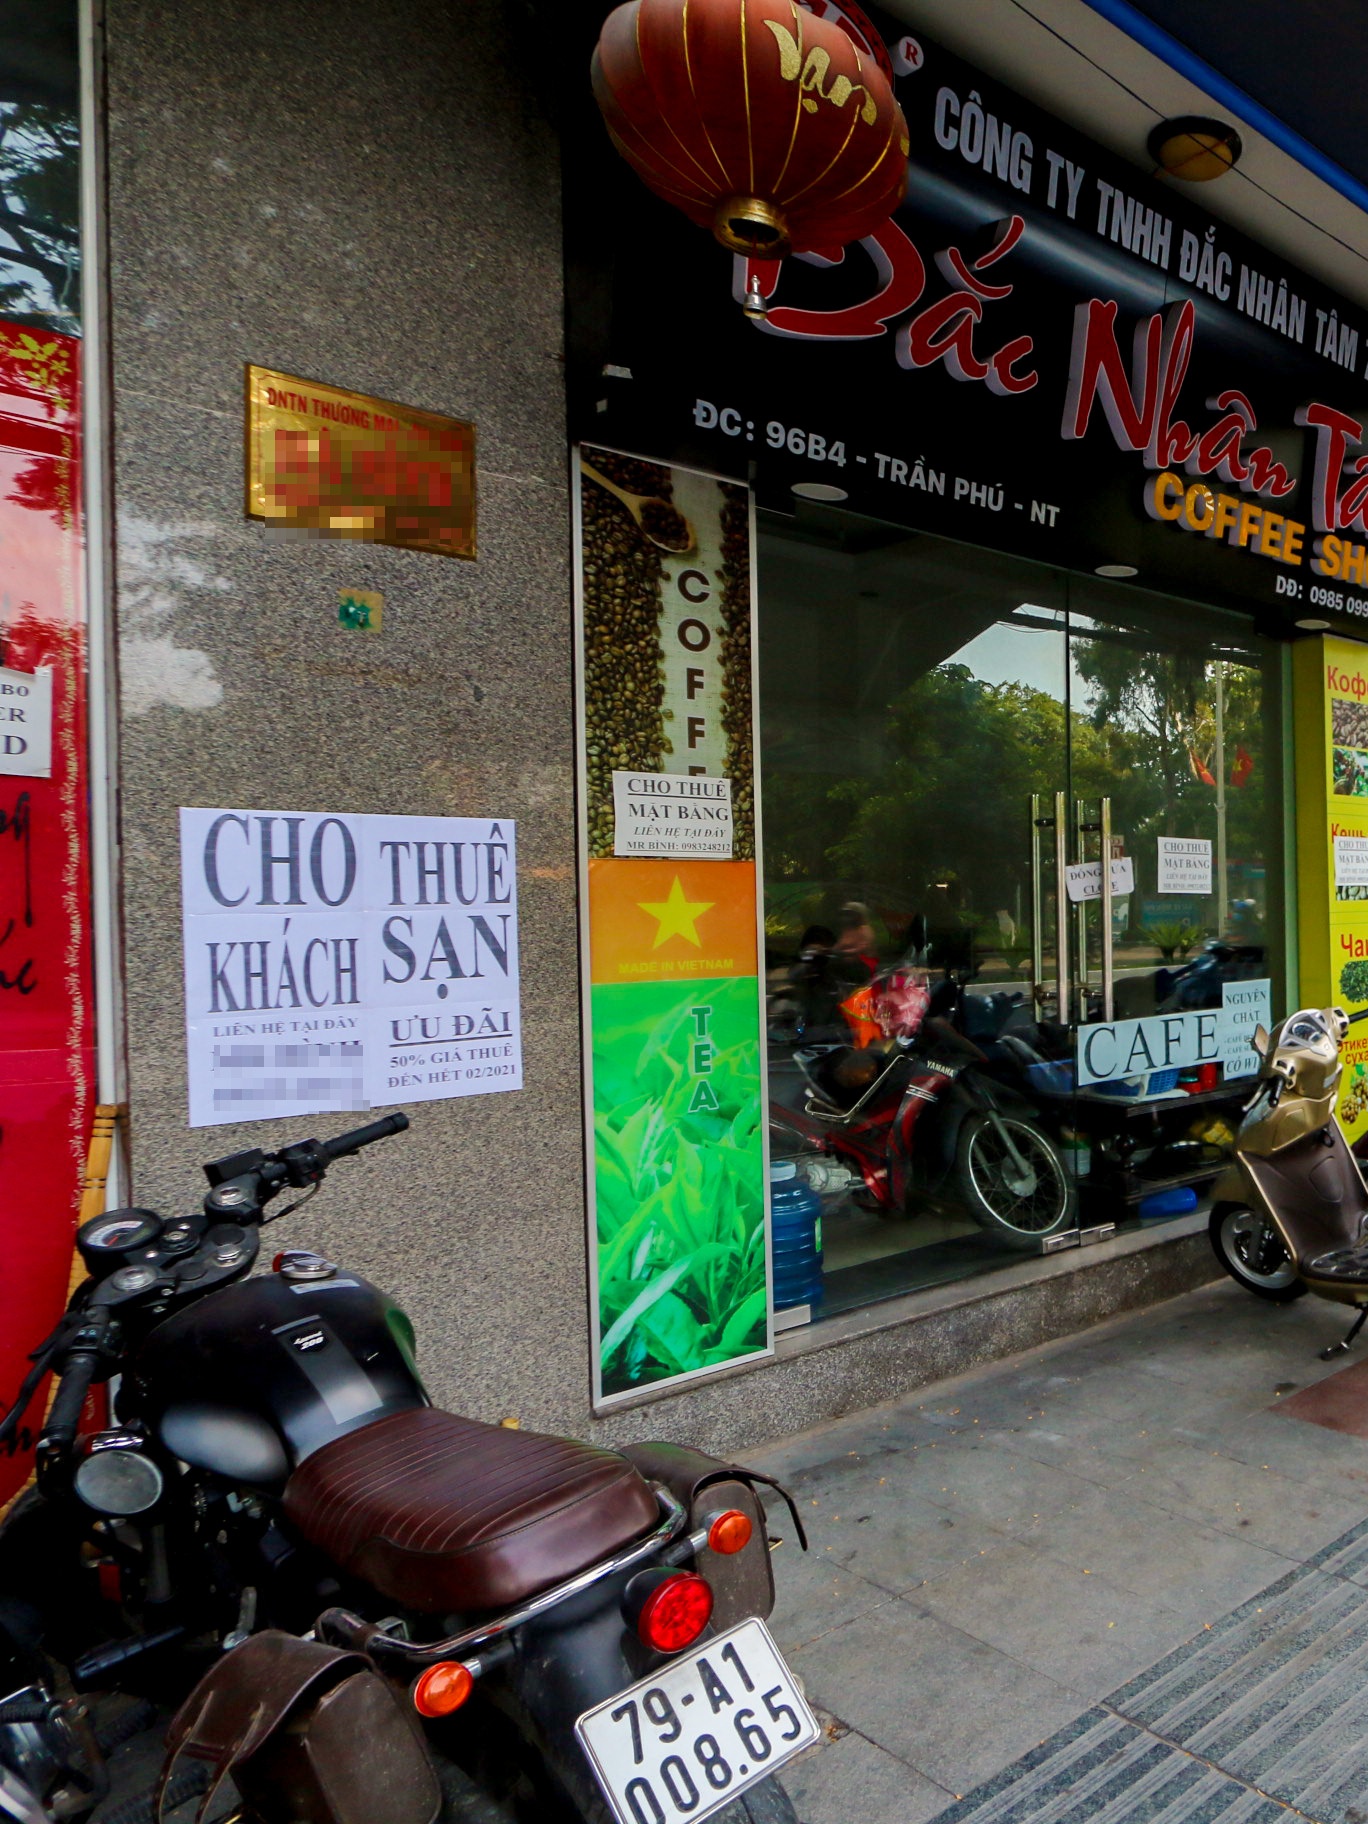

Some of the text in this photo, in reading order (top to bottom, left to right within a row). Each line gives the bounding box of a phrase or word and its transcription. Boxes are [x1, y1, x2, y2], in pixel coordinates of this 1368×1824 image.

[934, 87, 1034, 195] CÔNG
[1046, 148, 1086, 220] TY
[1096, 177, 1173, 270] TNHH
[1179, 225, 1233, 302] ĐẮC
[1237, 263, 1307, 344] NHÂN
[1314, 308, 1359, 373] TÂM
[267, 387, 308, 414] DNTN
[1065, 298, 1297, 498] Nhân
[692, 398, 755, 441] ĐC:
[765, 420, 847, 467] 96B4
[874, 451, 947, 496] TRẦN
[954, 483, 1004, 512] PHÚ
[1030, 499, 1061, 528] NT
[1152, 471, 1306, 566] COFFEE
[1275, 575, 1304, 599] DĐ:
[1310, 586, 1344, 611] 0985
[677, 569, 711, 777] COFF
[627, 778, 727, 797] CHO THUÊ
[628, 803, 729, 822] MẶT BẰNG
[627, 841, 645, 850] MR
[648, 840, 679, 850] BÌNH:
[634, 825, 727, 839] LIÊN HỆ TẠI ĐÂY
[1164, 842, 1209, 853] CHO THUÊ
[1339, 840, 1354, 849] CHO
[203, 813, 512, 907] CHO THUÊ
[205, 914, 512, 1013] KHÁCH SẠN
[618, 959, 734, 974] MADE IN VIETNAM
[1225, 988, 1267, 1006] NGUYÊN
[212, 1016, 359, 1038] LIÊN HỆ TẠI ĐÂY
[389, 1007, 513, 1042] ƯU ĐÃI
[389, 1044, 514, 1069] 50% GIÁ THUÊ
[688, 1005, 720, 1113] TEA
[1084, 1013, 1220, 1079] CAFE
[387, 1063, 517, 1089] ĐẾN HẾT 02/2021
[927, 1060, 954, 1078] YAMAHA
[611, 1642, 755, 1765] 79-A1
[625, 1685, 801, 1824] 008.65
